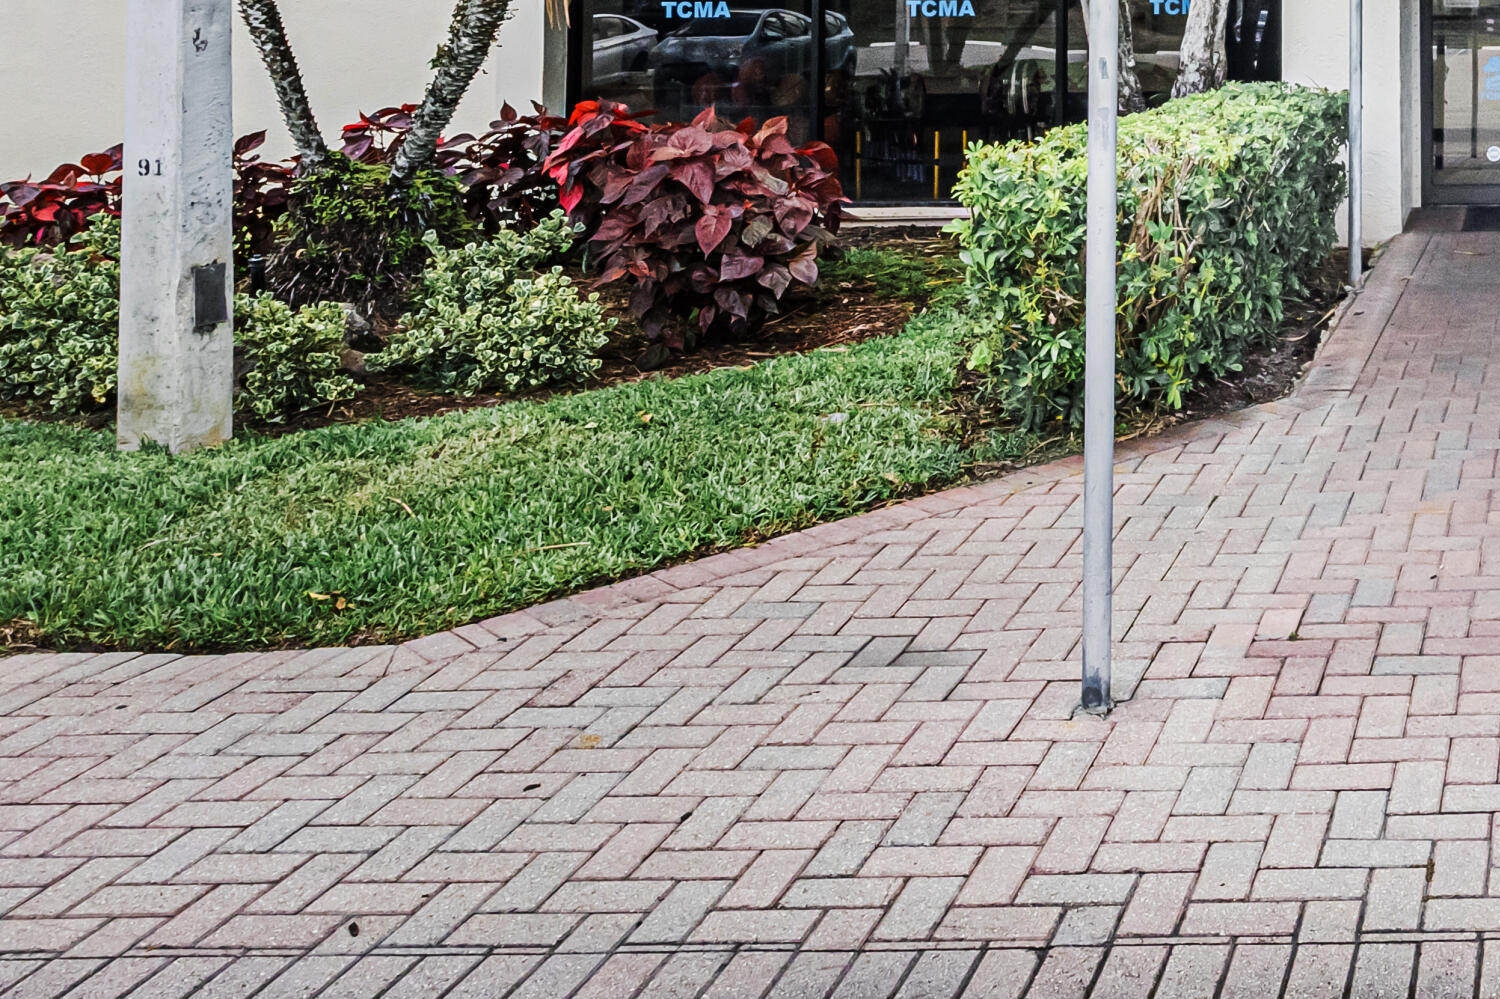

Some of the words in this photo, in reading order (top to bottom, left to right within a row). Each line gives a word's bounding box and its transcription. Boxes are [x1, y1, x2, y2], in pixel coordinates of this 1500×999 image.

[660, 0, 731, 20] TCMA
[906, 0, 976, 19] TCMA
[138, 158, 163, 177] 91
